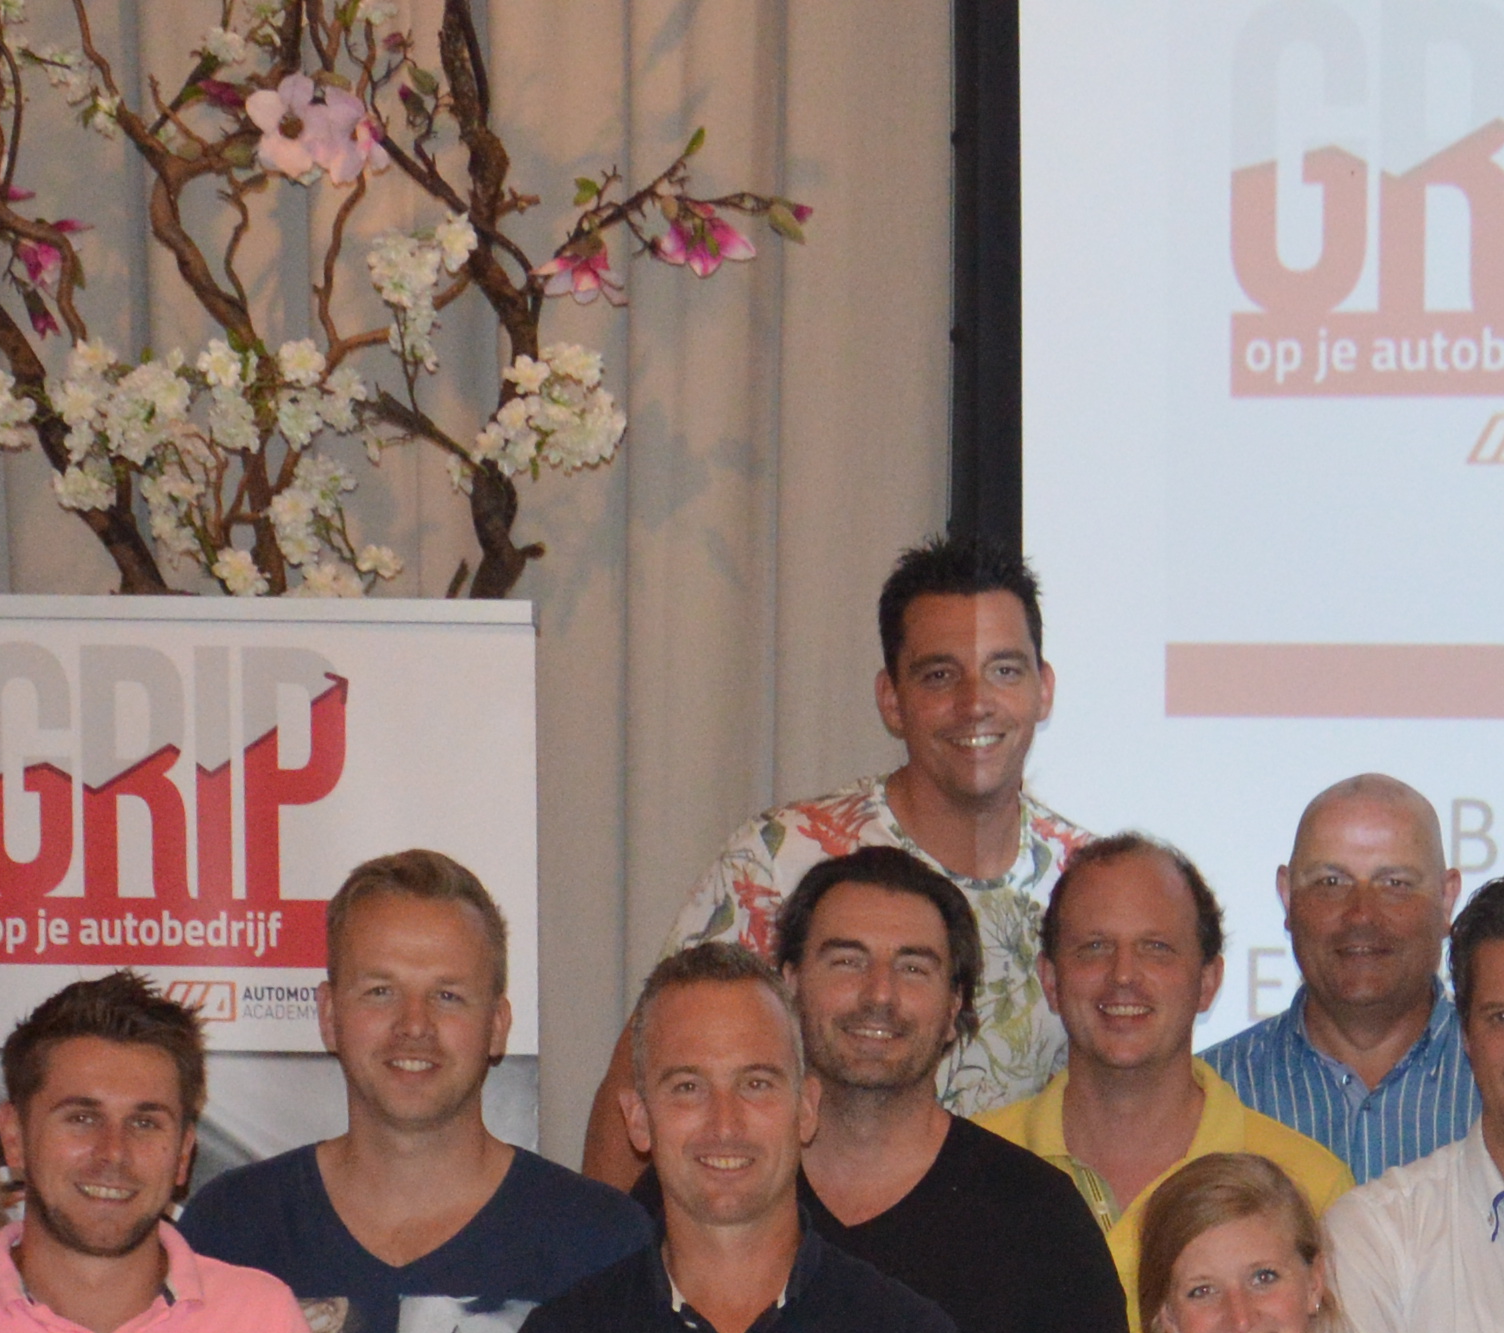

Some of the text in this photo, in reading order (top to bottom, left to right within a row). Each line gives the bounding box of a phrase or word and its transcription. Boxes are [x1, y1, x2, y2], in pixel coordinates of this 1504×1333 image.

[1245, 335, 1302, 384] op
[1315, 329, 1357, 384] je
[35, 908, 71, 954] je
[78, 909, 283, 958] autobedrijf
[243, 986, 319, 1002] AUTOMOT
